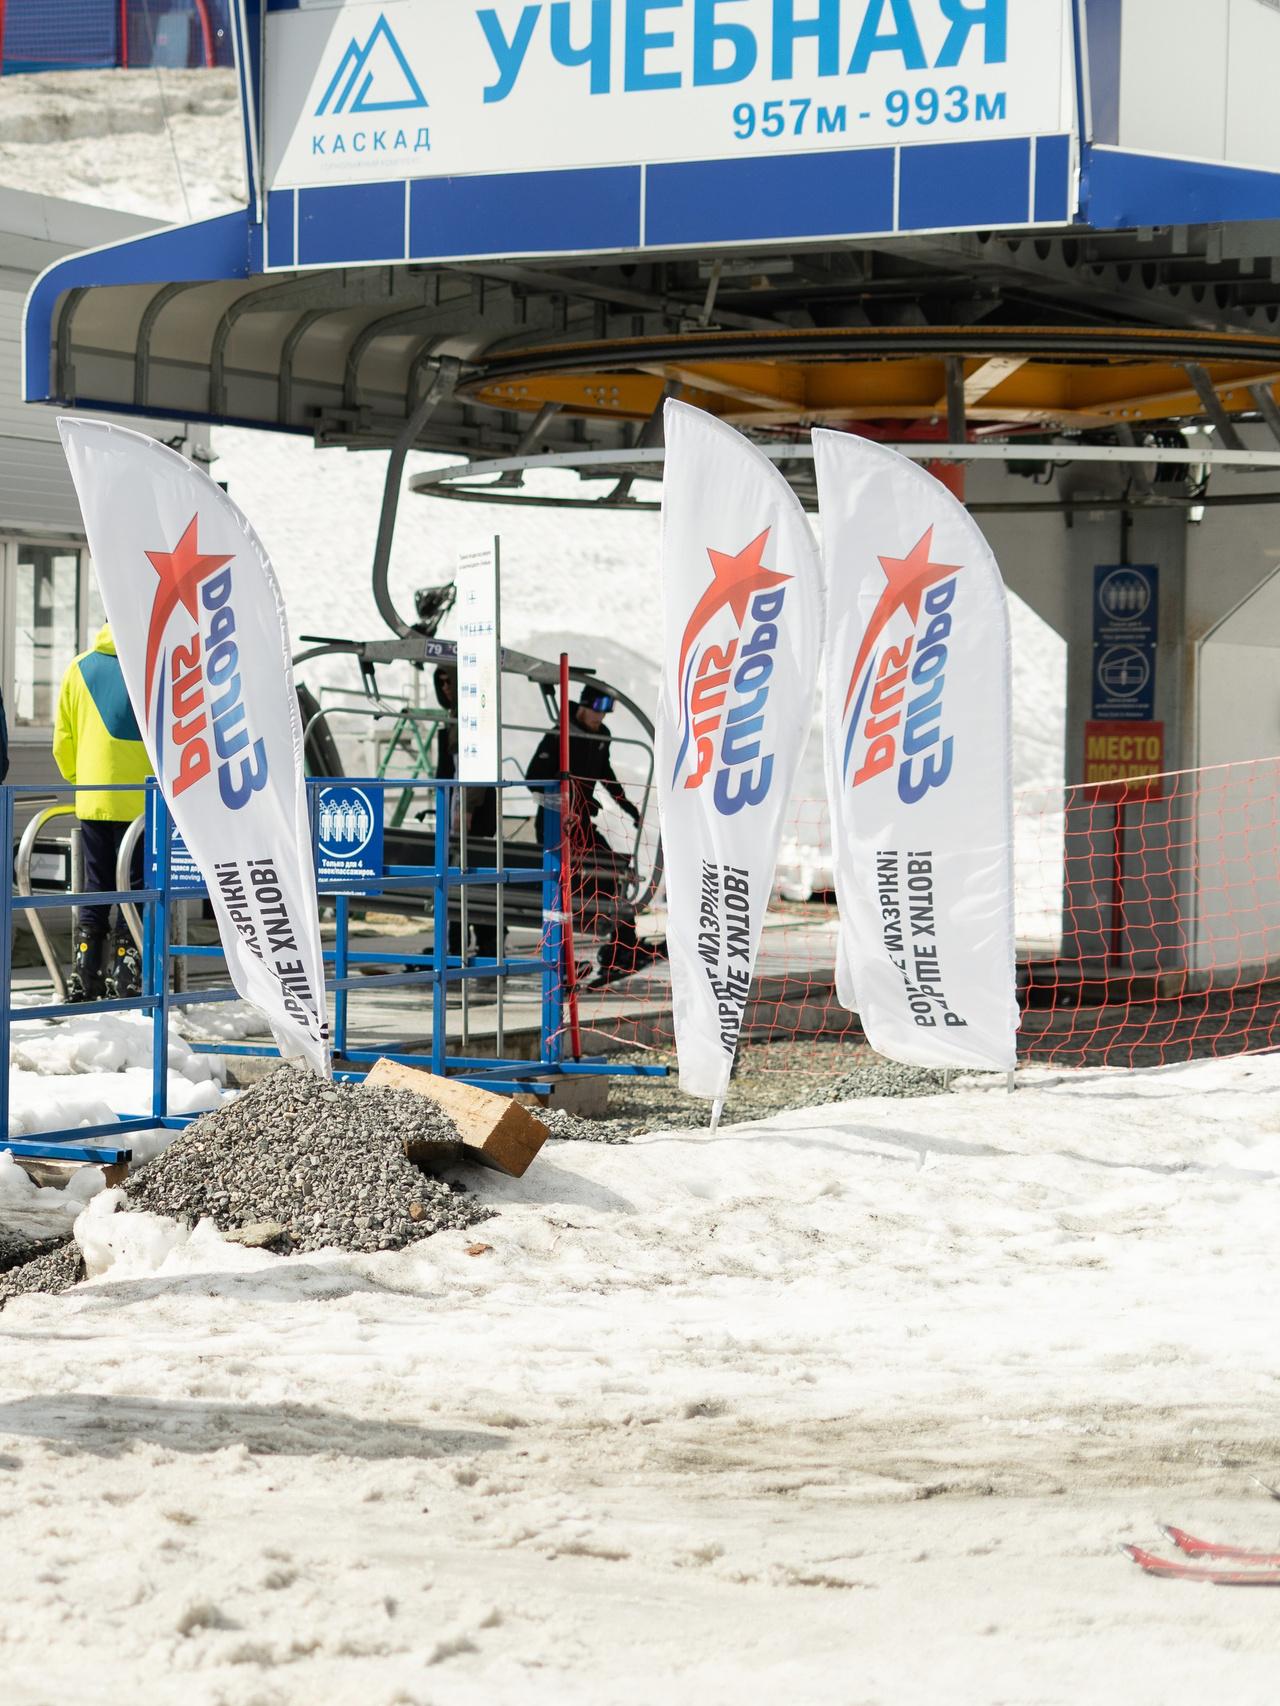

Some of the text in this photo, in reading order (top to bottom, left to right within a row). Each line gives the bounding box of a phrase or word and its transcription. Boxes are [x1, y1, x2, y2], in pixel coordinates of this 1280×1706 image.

[476, 0, 1008, 104] УЧЕБНАЯ
[732, 97, 847, 140] 957м
[884, 84, 1007, 128] 993м
[312, 127, 431, 155] КАСКАД
[1088, 735, 1160, 761] МЕСТО
